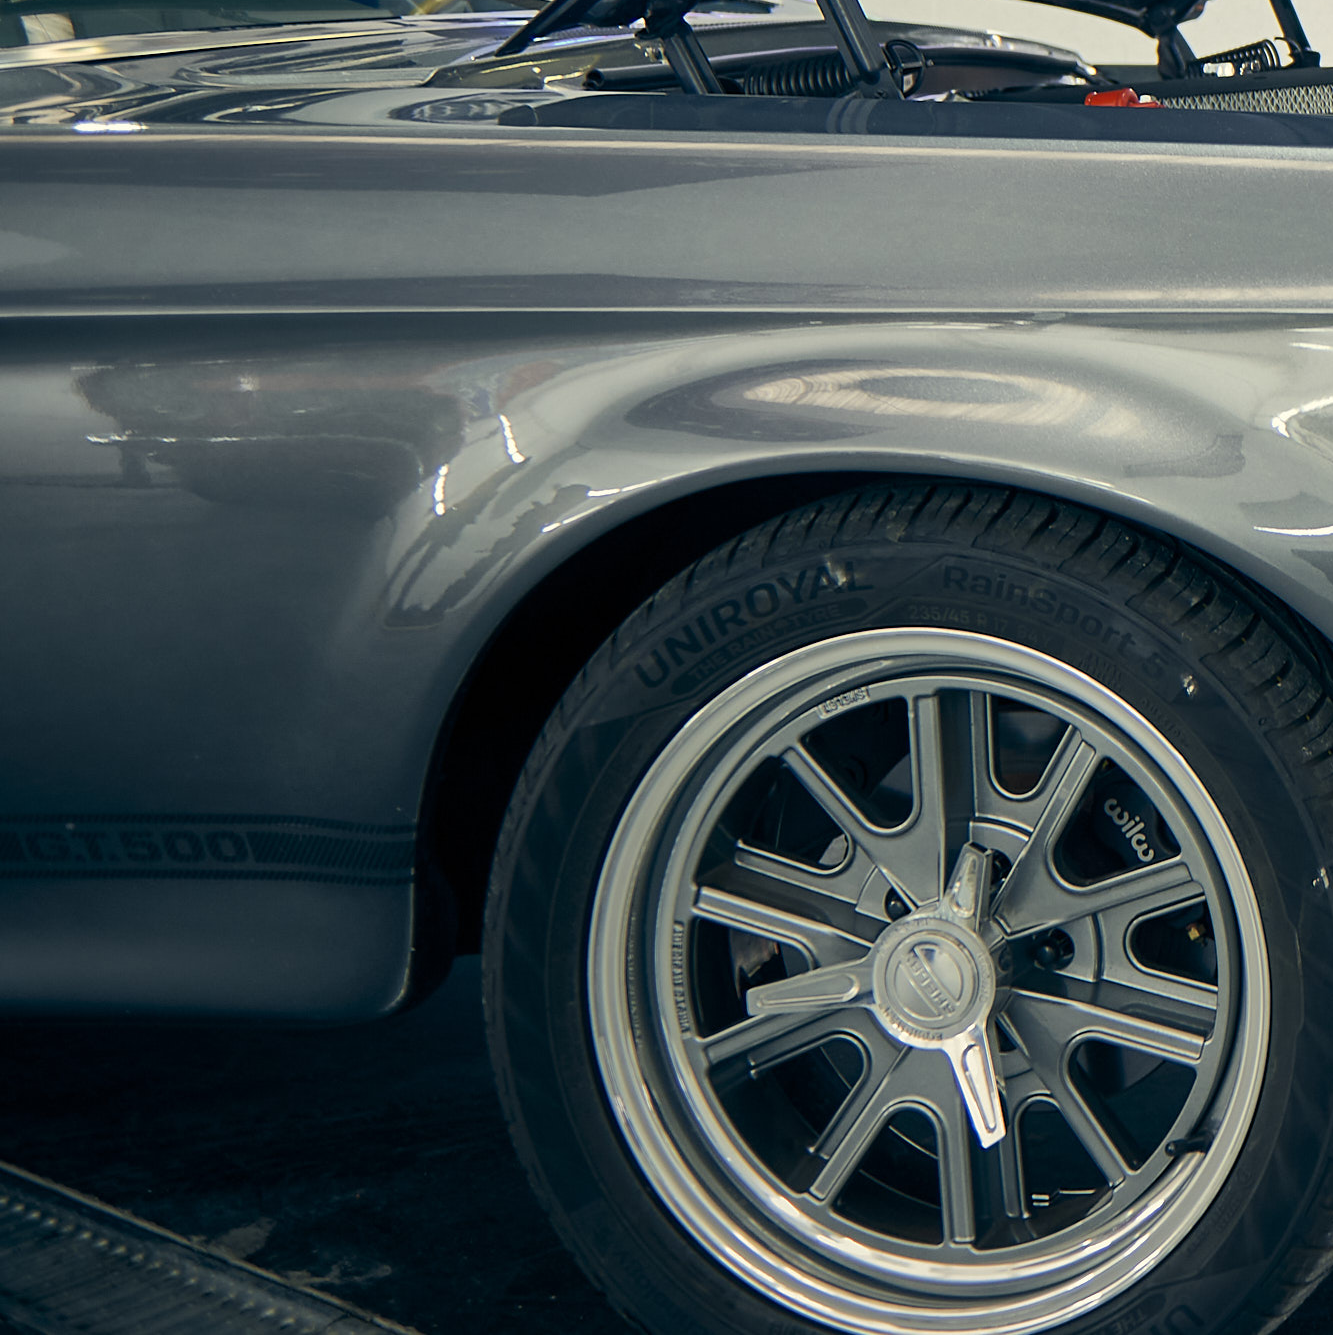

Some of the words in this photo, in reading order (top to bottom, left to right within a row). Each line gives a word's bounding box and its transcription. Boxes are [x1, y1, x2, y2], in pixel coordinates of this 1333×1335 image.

[633, 559, 875, 690] UNIROYAL
[729, 622, 777, 658] RAIN
[788, 602, 842, 631] TYRE
[908, 604, 971, 626] 235/45
[941, 564, 1138, 656] RainSport
[1103, 797, 1155, 863] wilw
